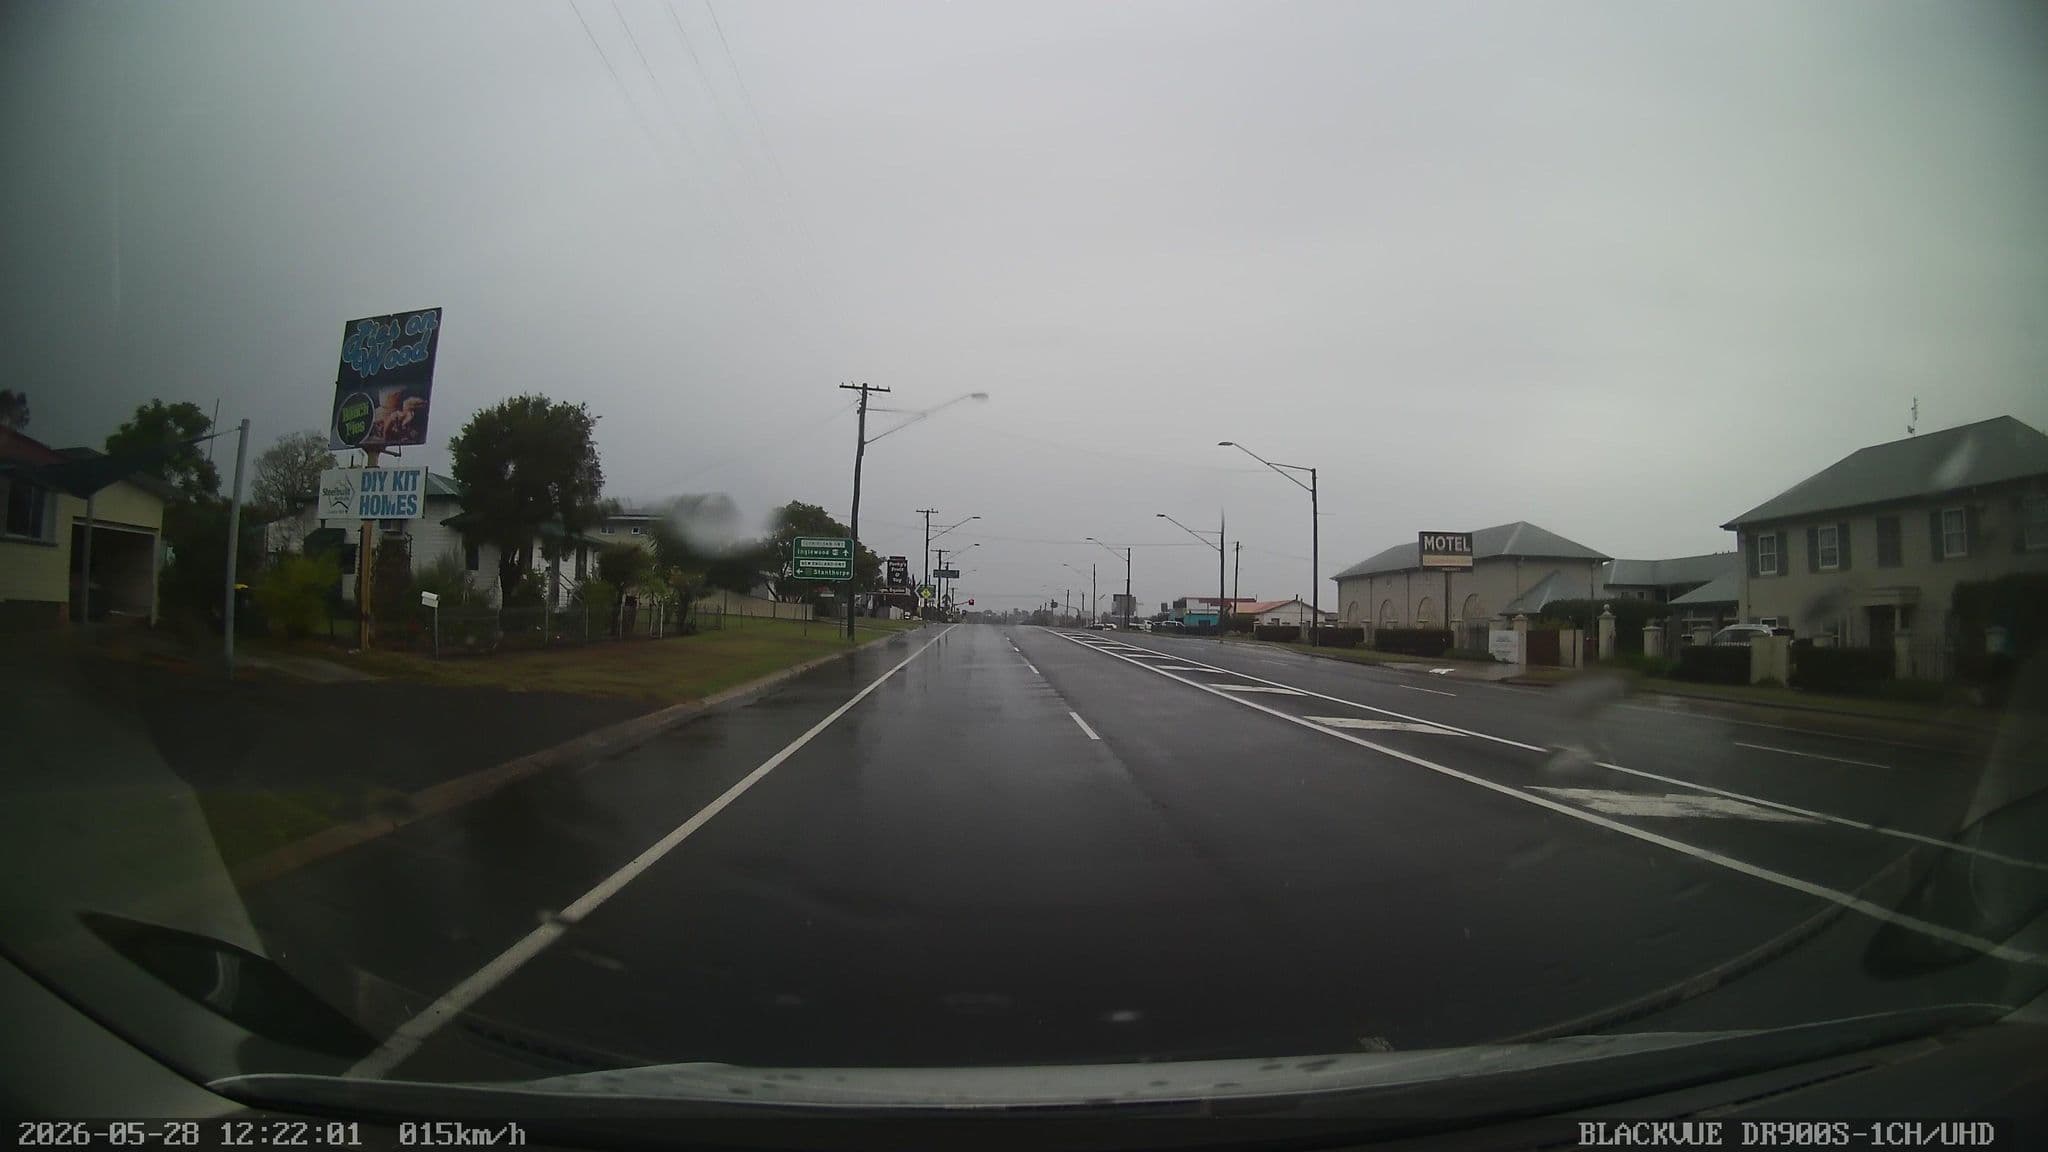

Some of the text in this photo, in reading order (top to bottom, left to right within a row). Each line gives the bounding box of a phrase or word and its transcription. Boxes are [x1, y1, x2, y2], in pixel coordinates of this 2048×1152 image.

[352, 328, 432, 378] Wood
[361, 470, 420, 492] DIY KIT
[359, 494, 418, 516] HOMES
[1424, 536, 1471, 552] MOTEL
[813, 569, 850, 577] Stanthorpe
